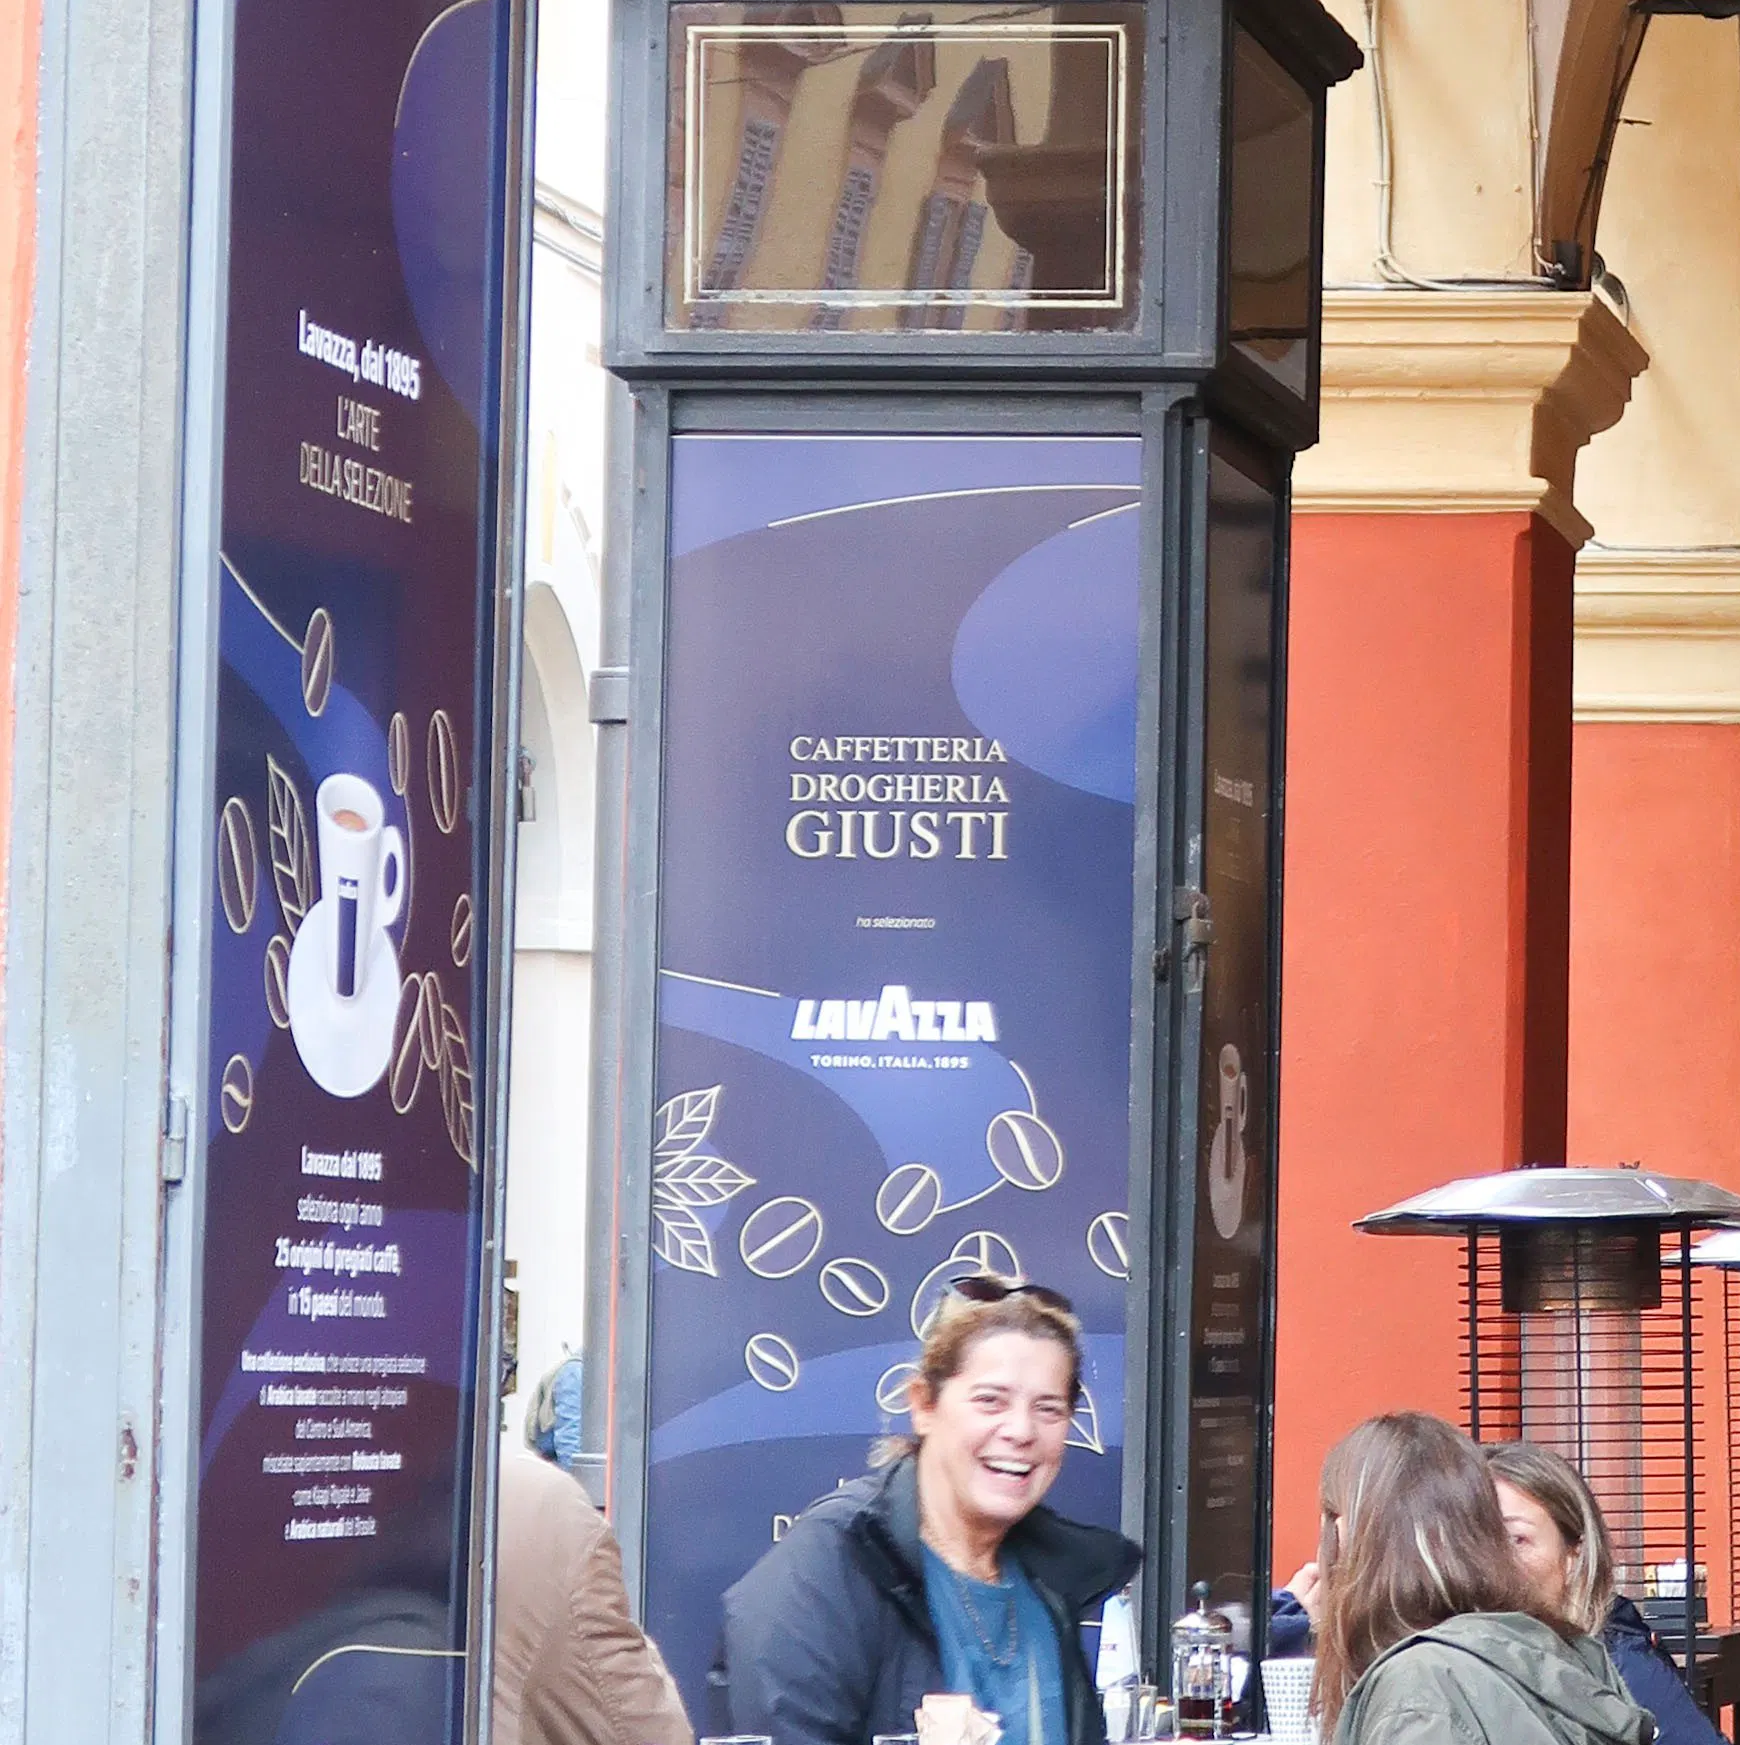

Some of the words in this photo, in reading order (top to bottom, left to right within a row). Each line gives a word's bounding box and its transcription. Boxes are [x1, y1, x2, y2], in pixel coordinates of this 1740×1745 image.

[299, 309, 359, 383] Lavazza,
[361, 339, 384, 386] dal
[386, 348, 421, 400] 1895
[300, 441, 342, 498] DELLA
[343, 458, 413, 524] SELEZIONE
[789, 736, 1008, 763] CAFFETTERIA
[789, 774, 1010, 803] DROGHERIA
[785, 810, 1009, 860] GIUSTI
[856, 915, 871, 928] ha
[873, 915, 936, 929] selezionato
[790, 984, 999, 1042] LAVAZZA
[935, 1056, 969, 1070] 1895
[341, 1148, 356, 1179] dal
[357, 1151, 382, 1181] 1895
